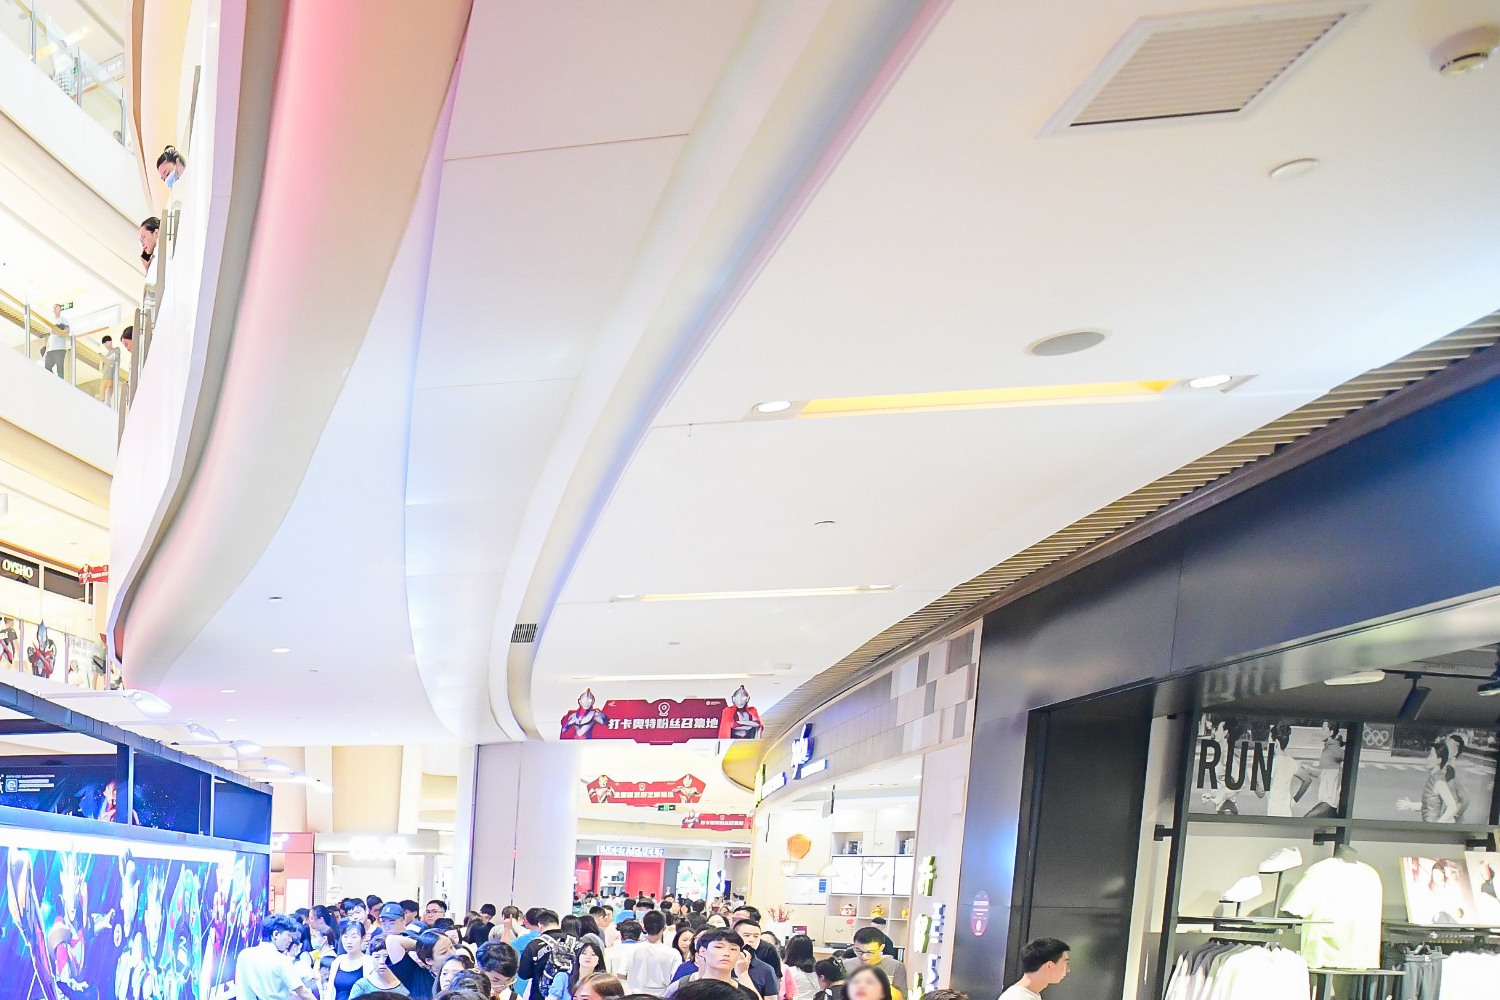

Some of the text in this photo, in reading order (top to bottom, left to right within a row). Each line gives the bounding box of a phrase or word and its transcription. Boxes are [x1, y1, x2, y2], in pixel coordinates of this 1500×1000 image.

[1, 559, 34, 579] OYSHO
[608, 718, 719, 730] 打卡奥特粉丝召集地
[1196, 739, 1276, 792] RUN
